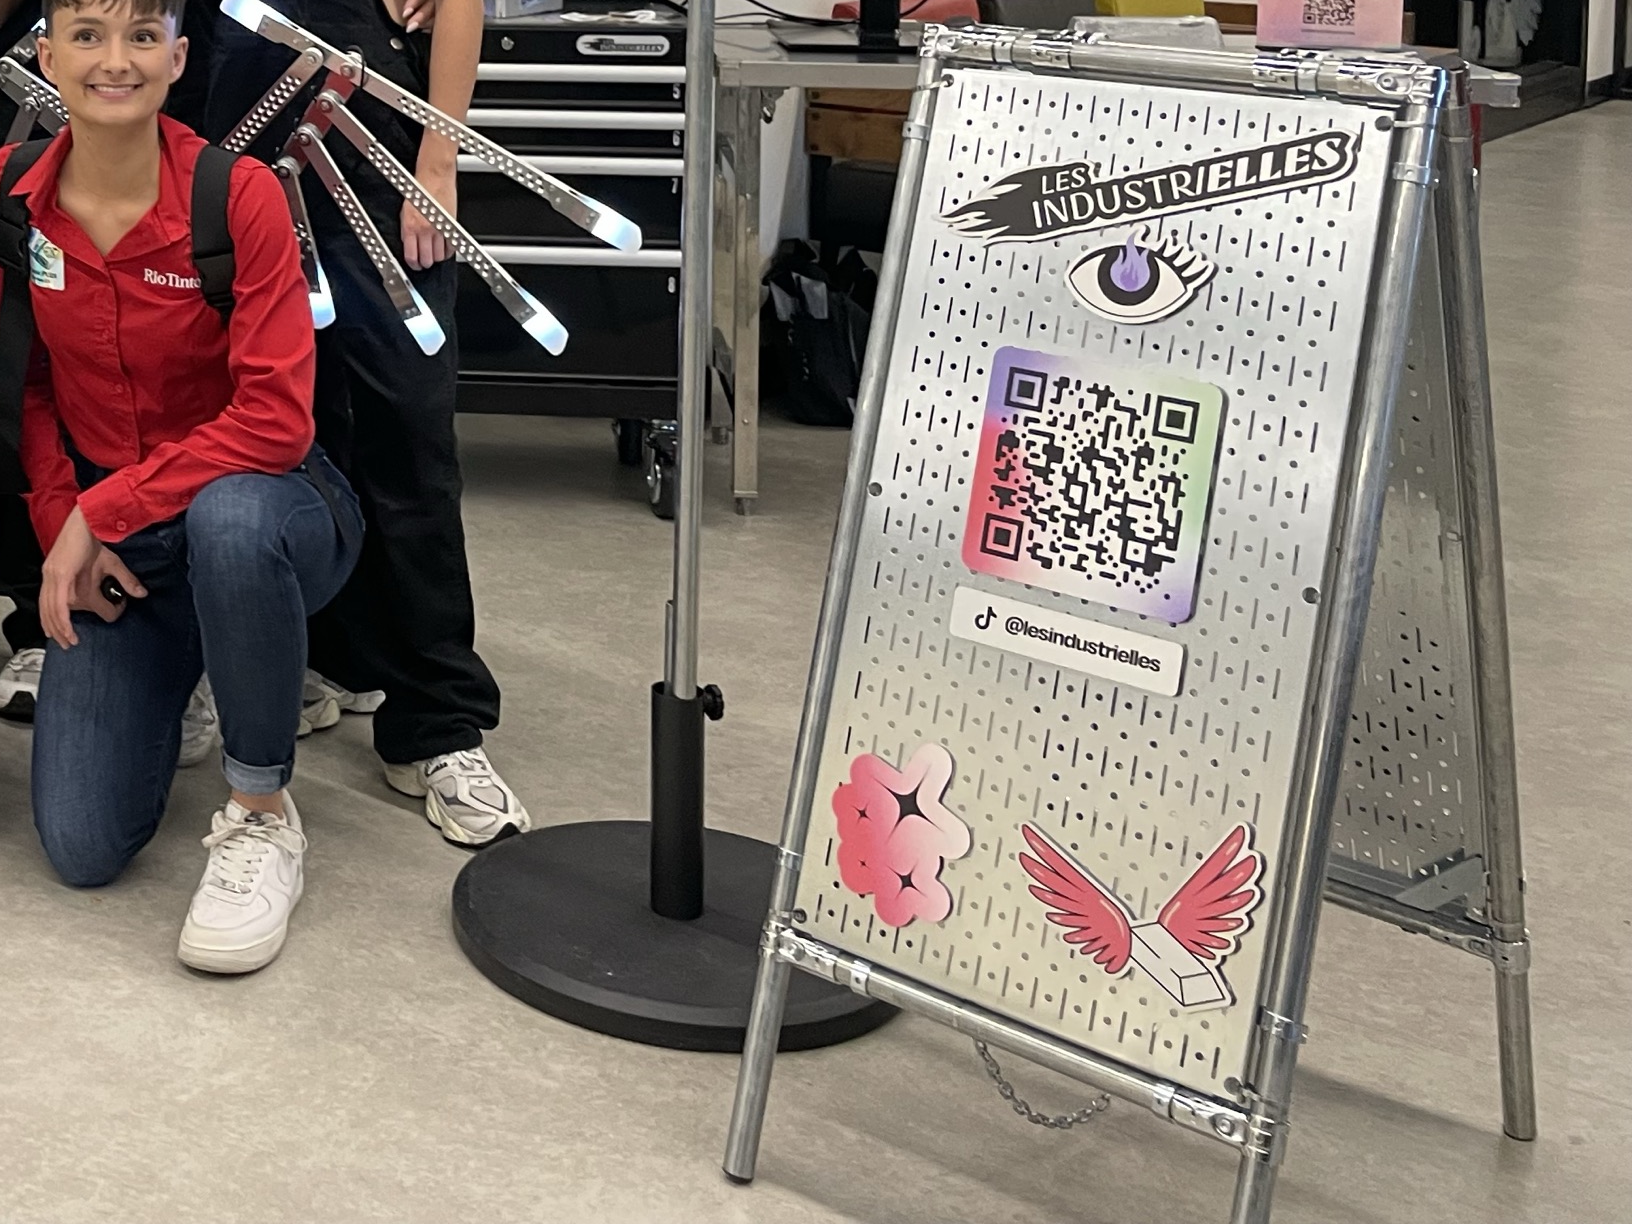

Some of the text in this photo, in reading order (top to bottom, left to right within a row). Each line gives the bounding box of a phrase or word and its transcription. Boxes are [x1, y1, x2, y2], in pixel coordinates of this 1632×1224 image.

[1032, 138, 1343, 229] INDUSTRIELLES
[1041, 167, 1086, 195] LES
[1004, 616, 1161, 672] @lesindustrielles
